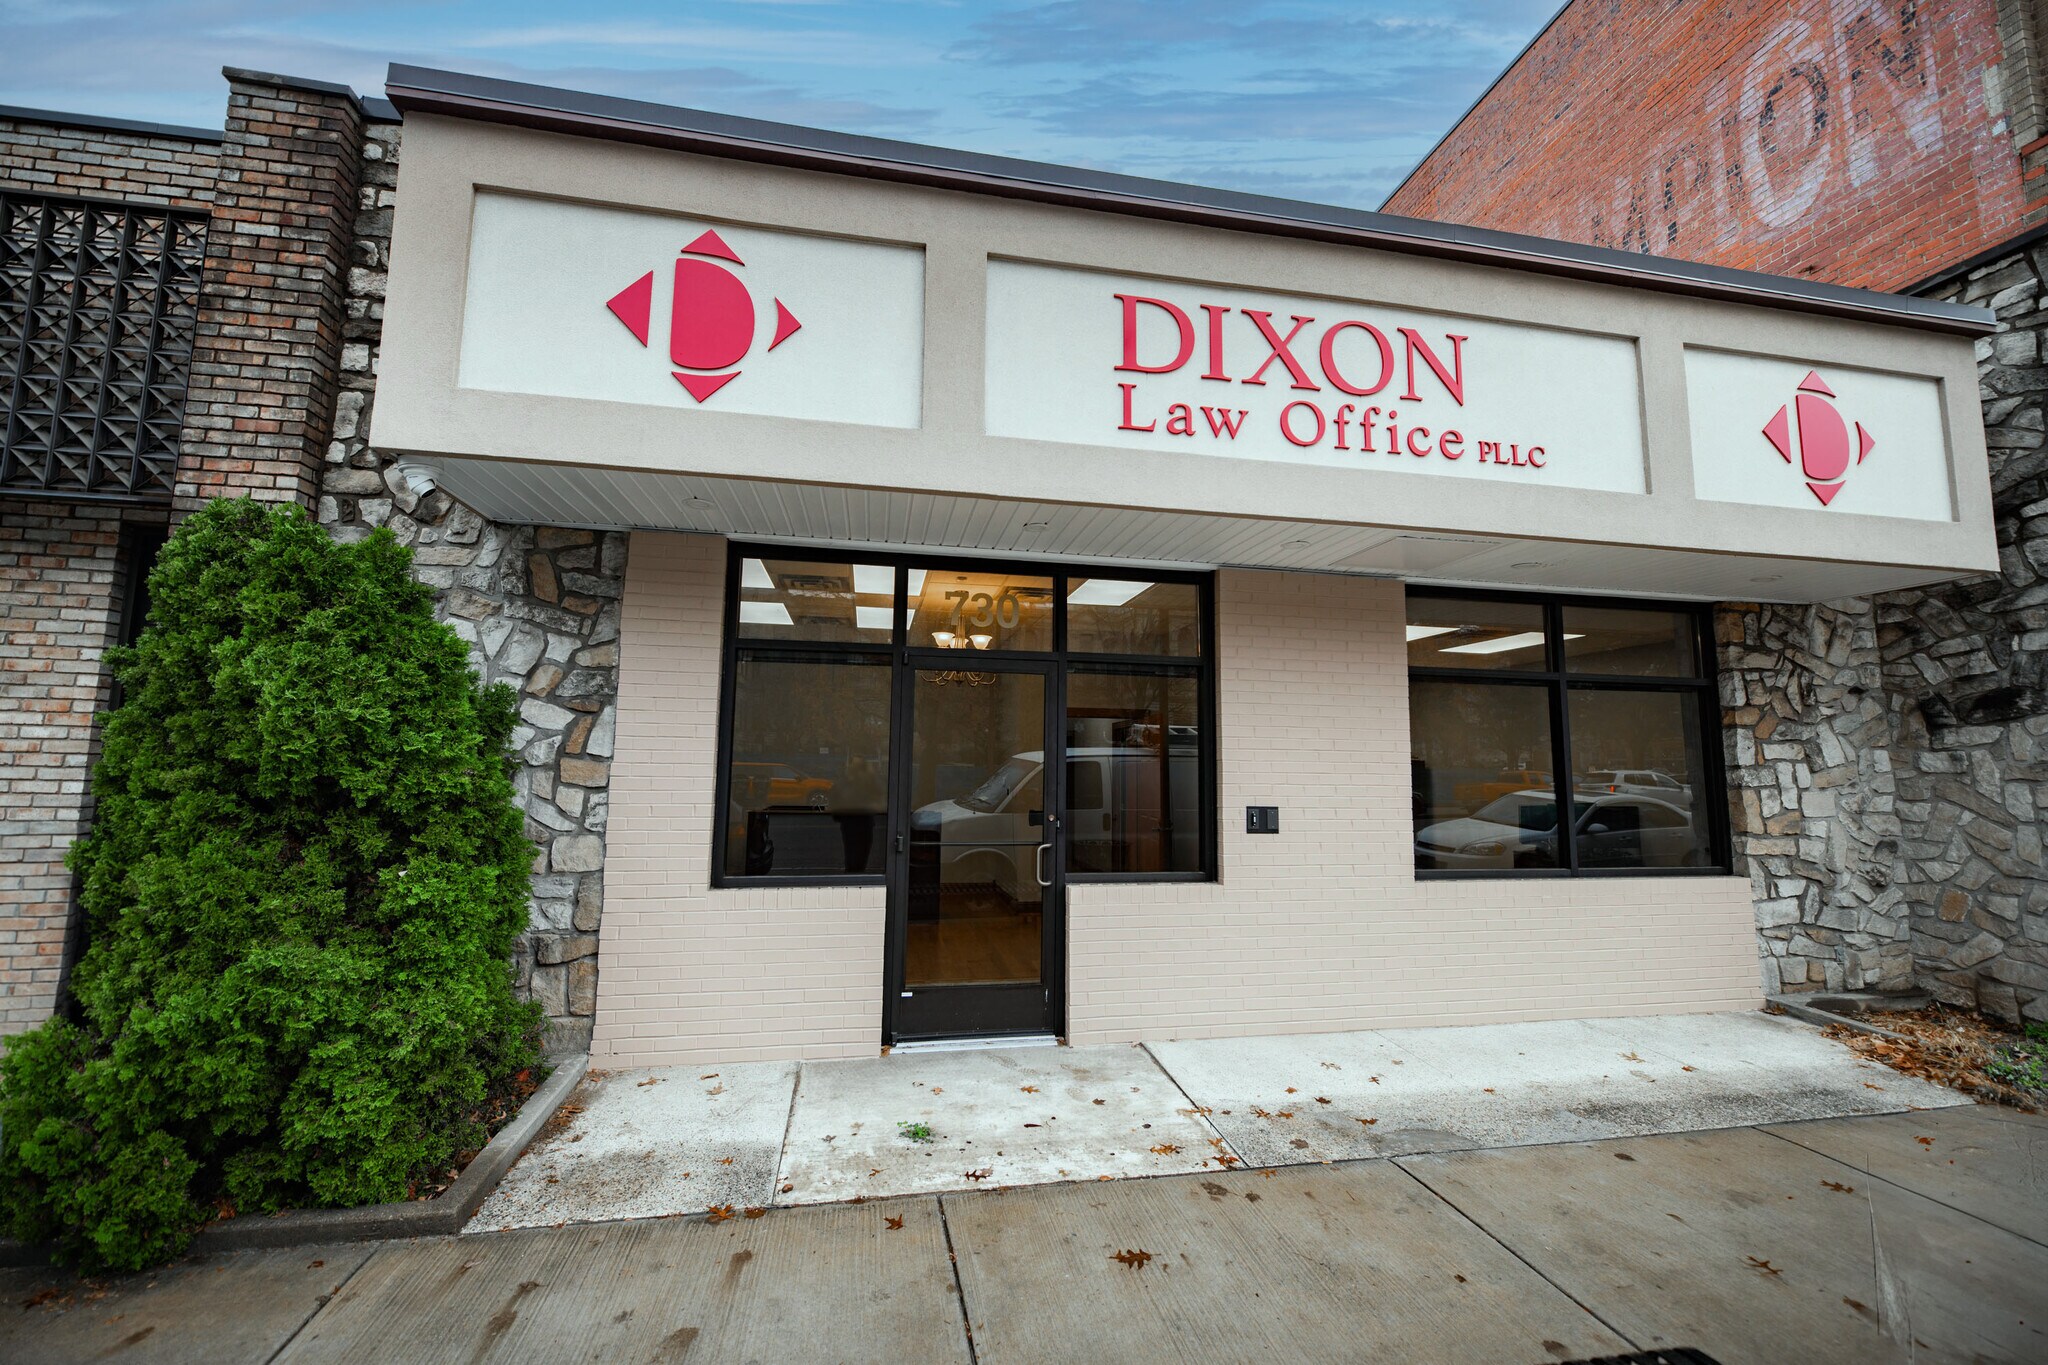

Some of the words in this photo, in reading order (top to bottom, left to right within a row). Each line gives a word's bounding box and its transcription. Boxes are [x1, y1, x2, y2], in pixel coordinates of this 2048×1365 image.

[1113, 293, 1469, 407] DIXON
[1117, 382, 1249, 440] Law
[1279, 400, 1466, 461] Office
[1477, 440, 1547, 468] PLLC
[944, 590, 1020, 629] 730
